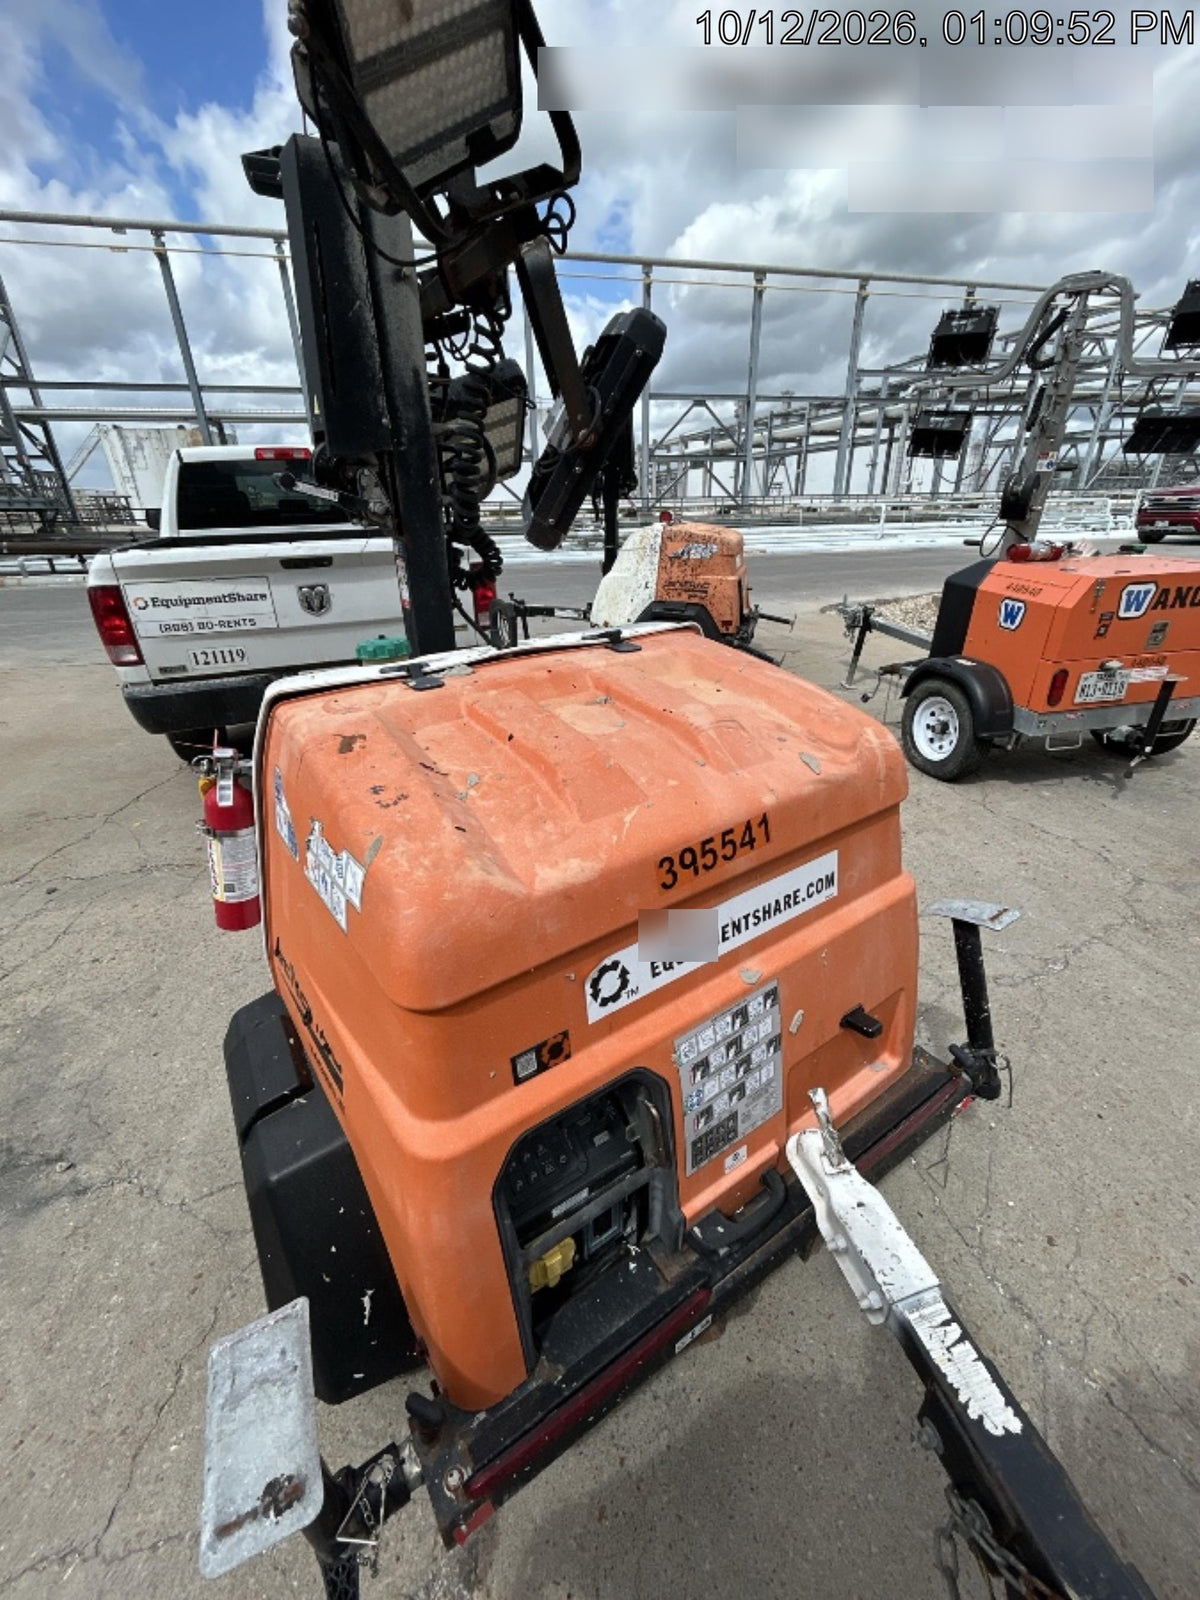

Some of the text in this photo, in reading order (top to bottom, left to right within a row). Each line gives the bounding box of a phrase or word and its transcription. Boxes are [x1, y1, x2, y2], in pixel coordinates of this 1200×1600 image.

[150, 592, 268, 609] EquipmentShare
[1003, 603, 1023, 626] W
[191, 647, 246, 666] 121119
[657, 812, 772, 890] 395541
[624, 986, 639, 1000] TM
